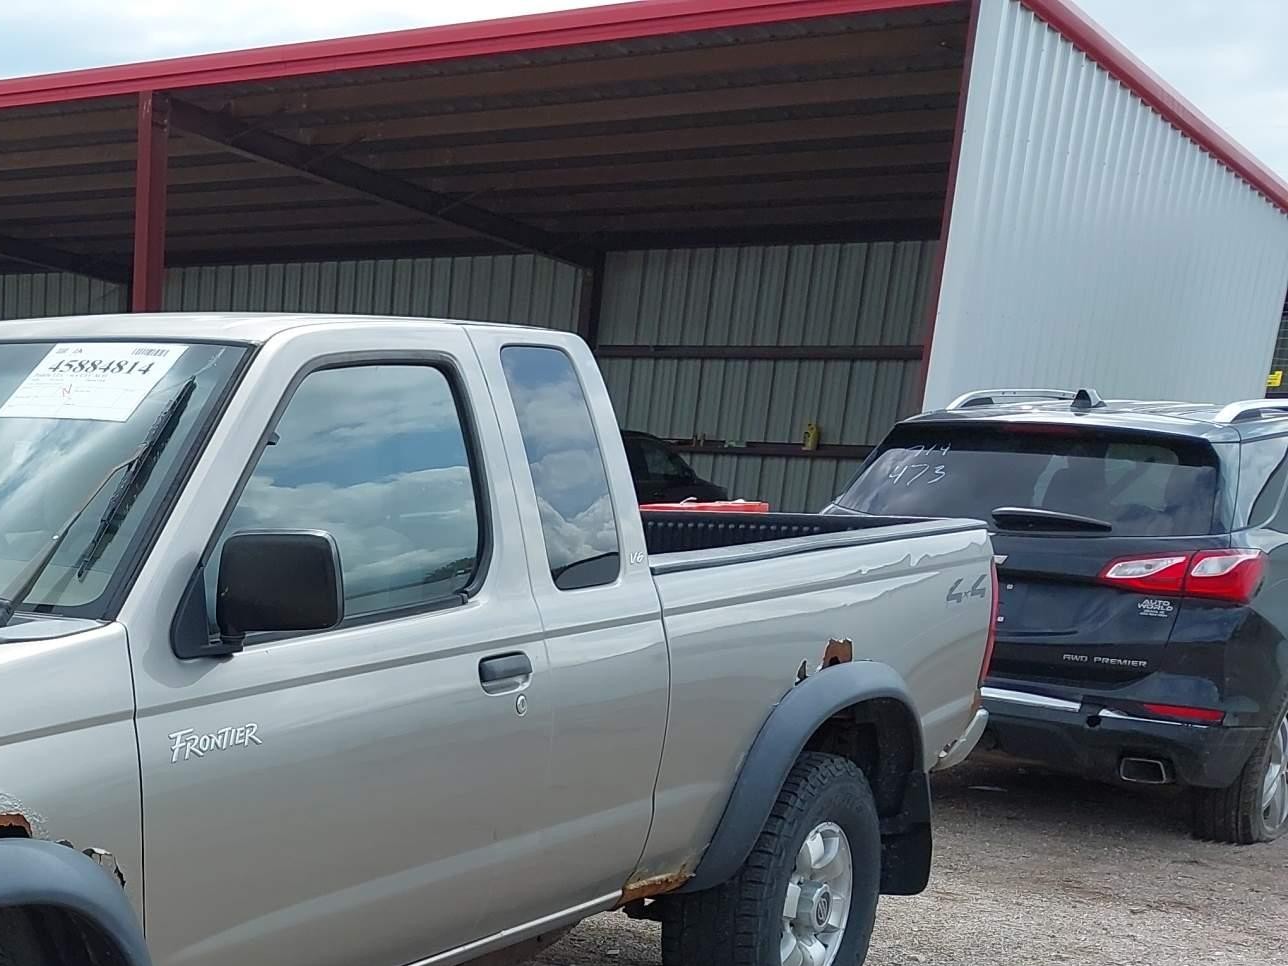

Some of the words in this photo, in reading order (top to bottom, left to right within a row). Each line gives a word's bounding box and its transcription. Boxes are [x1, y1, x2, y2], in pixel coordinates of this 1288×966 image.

[48, 359, 155, 375] 45884814
[889, 464, 946, 486] 473
[630, 551, 645, 564] V6
[1137, 603, 1174, 611] WORLD
[1063, 653, 1089, 662] AWD
[1093, 656, 1148, 668] PREMIER
[168, 723, 263, 763] FRONTIER
